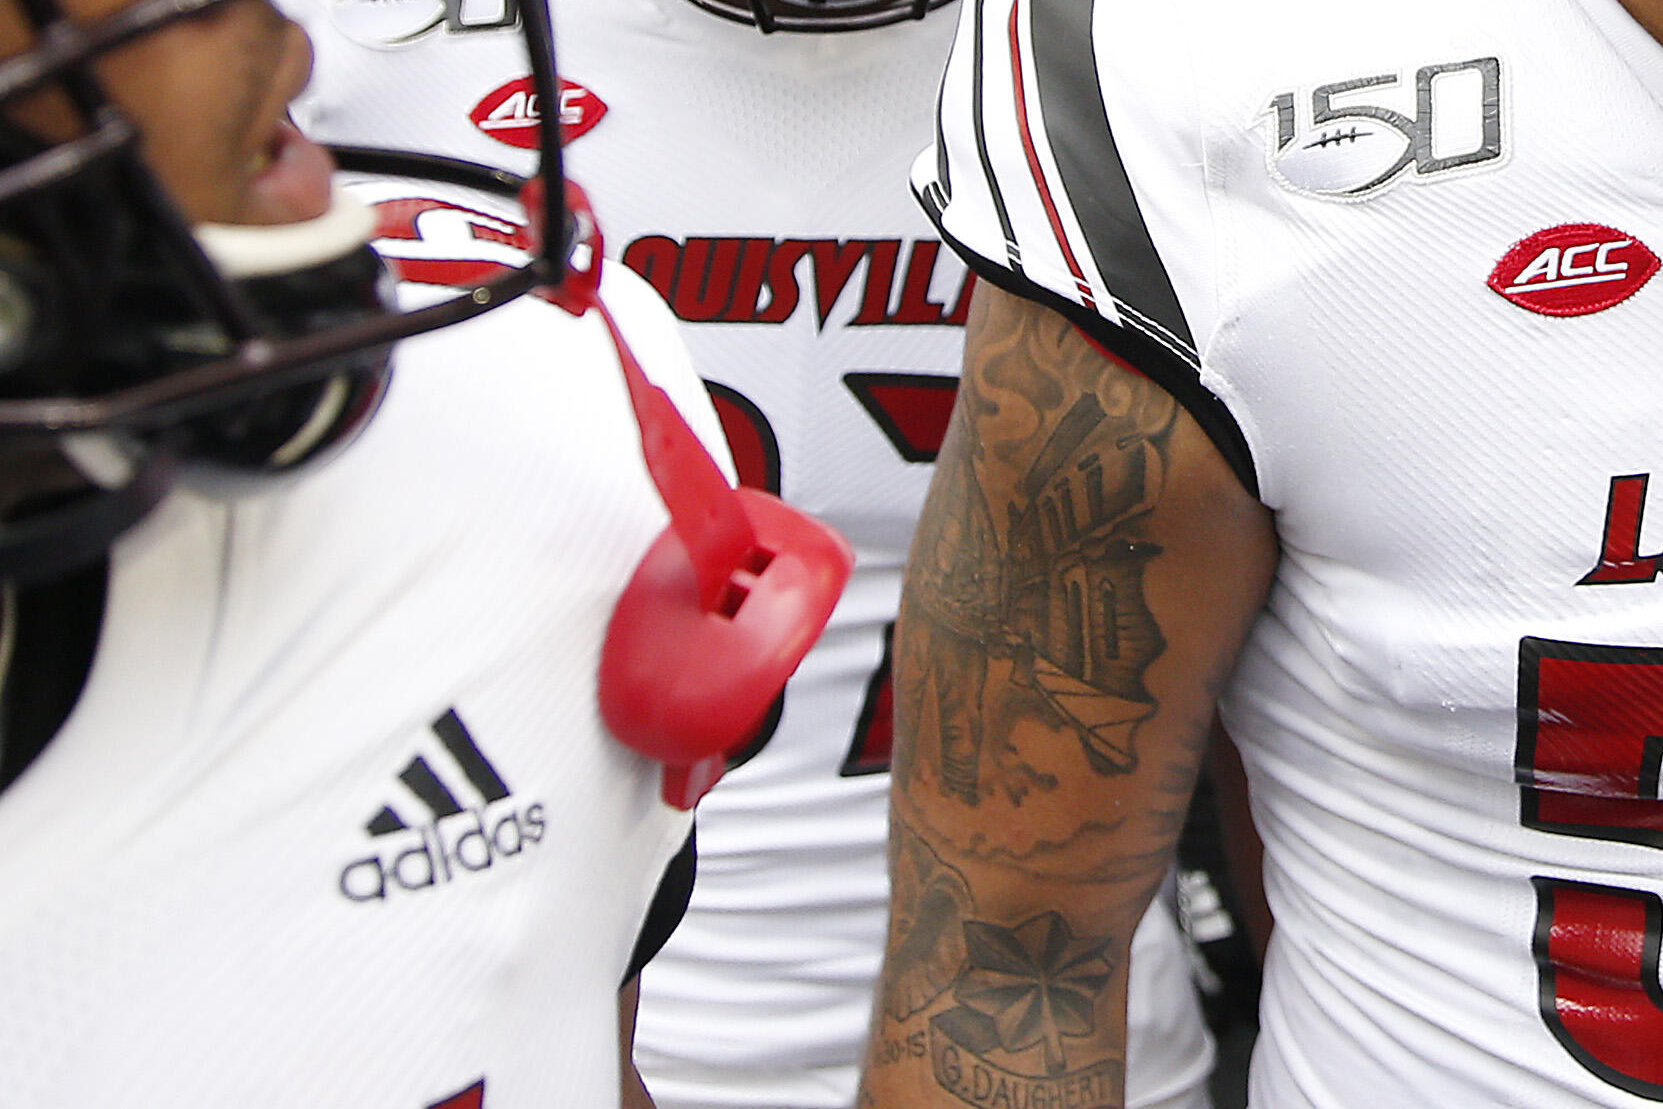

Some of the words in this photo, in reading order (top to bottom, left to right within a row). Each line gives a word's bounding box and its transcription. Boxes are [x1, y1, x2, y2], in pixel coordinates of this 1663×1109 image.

[1267, 55, 1504, 195] 150
[1512, 237, 1634, 286] ACC
[339, 802, 546, 902] adidas
